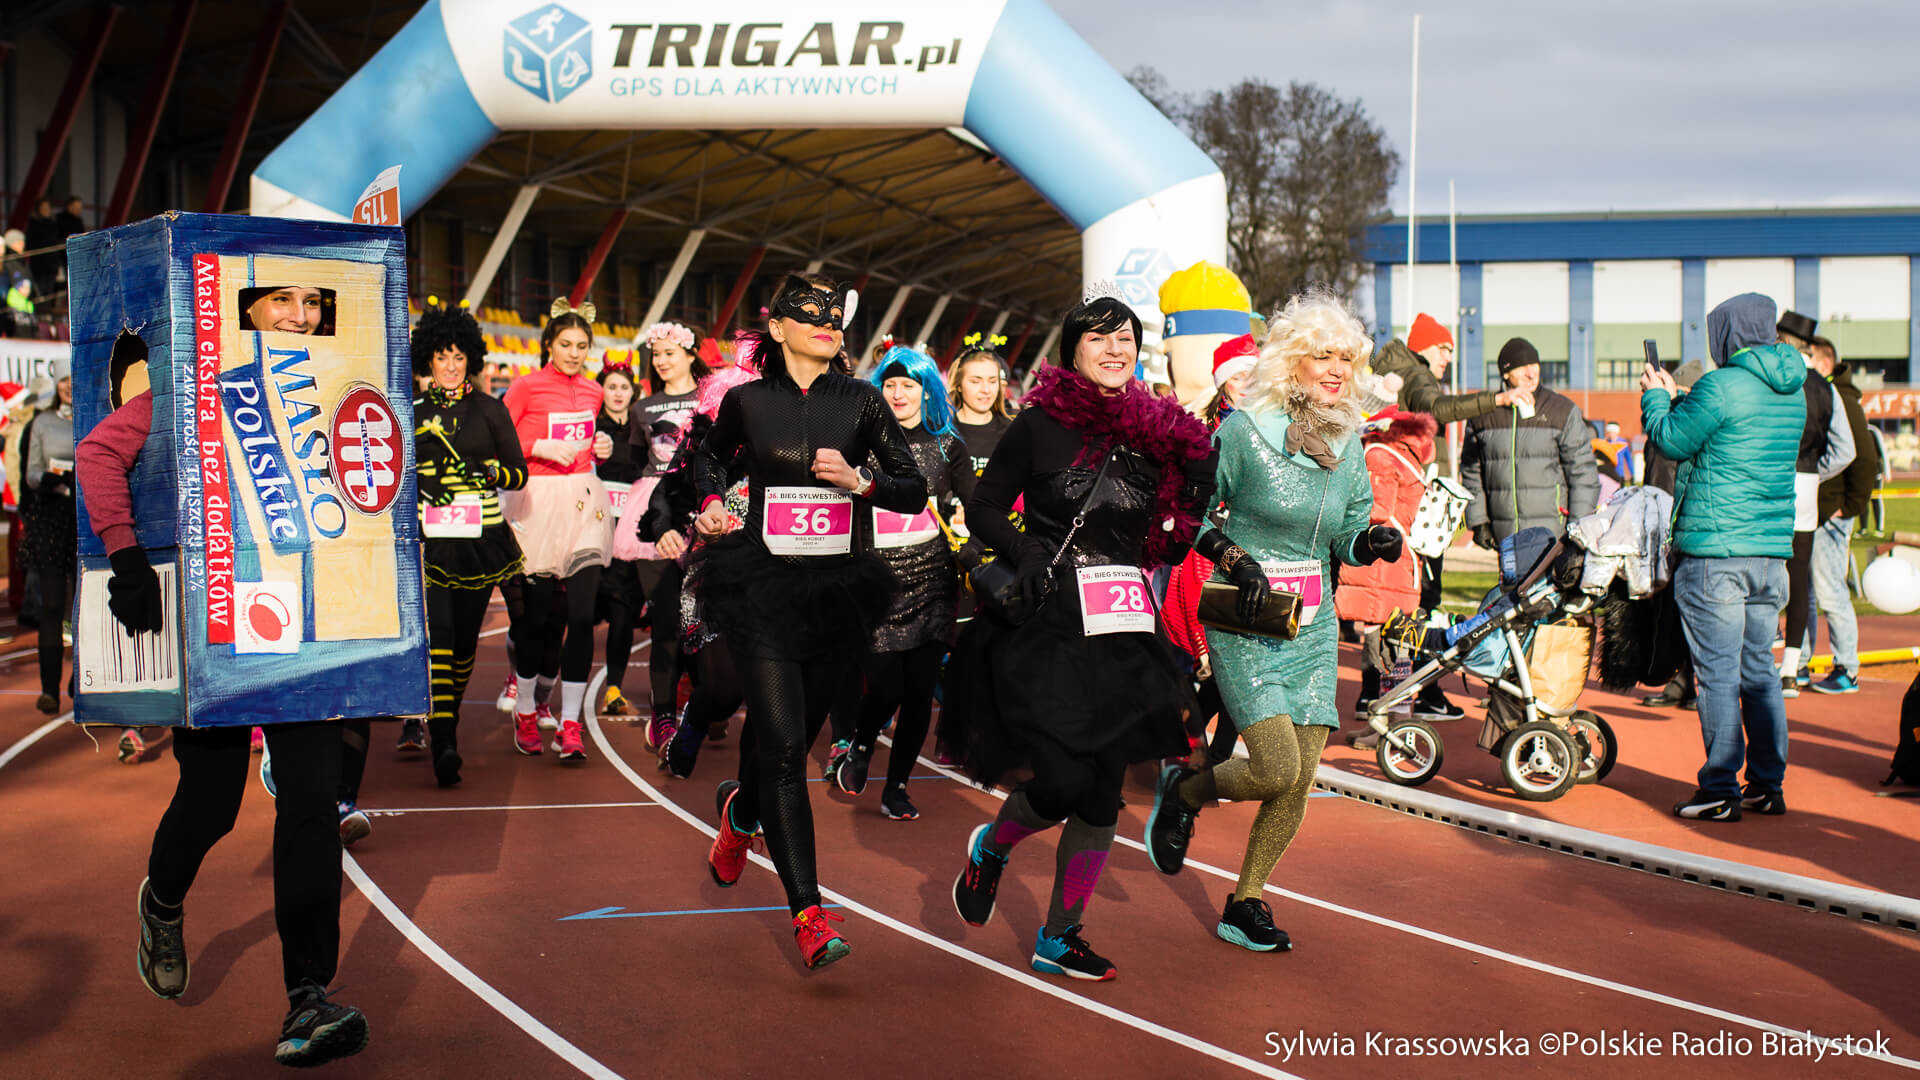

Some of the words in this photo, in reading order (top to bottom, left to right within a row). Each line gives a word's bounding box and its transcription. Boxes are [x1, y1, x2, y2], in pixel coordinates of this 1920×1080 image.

[609, 21, 962, 72] TRIGAR.pl
[609, 77, 662, 97] GPS
[674, 77, 725, 97] DLA
[734, 75, 898, 96] AKTYWNYCH
[200, 341, 219, 422] ekstra
[266, 345, 346, 539] MASŁO
[564, 424, 586, 441] 26
[202, 440, 222, 484] bez
[440, 506, 466, 524] 32
[790, 508, 831, 534] 36
[901, 513, 914, 532] 7
[206, 495, 233, 626] dodatków
[189, 558, 205, 592] 82%
[1108, 585, 1144, 611] 28
[84, 670, 93, 687] 5
